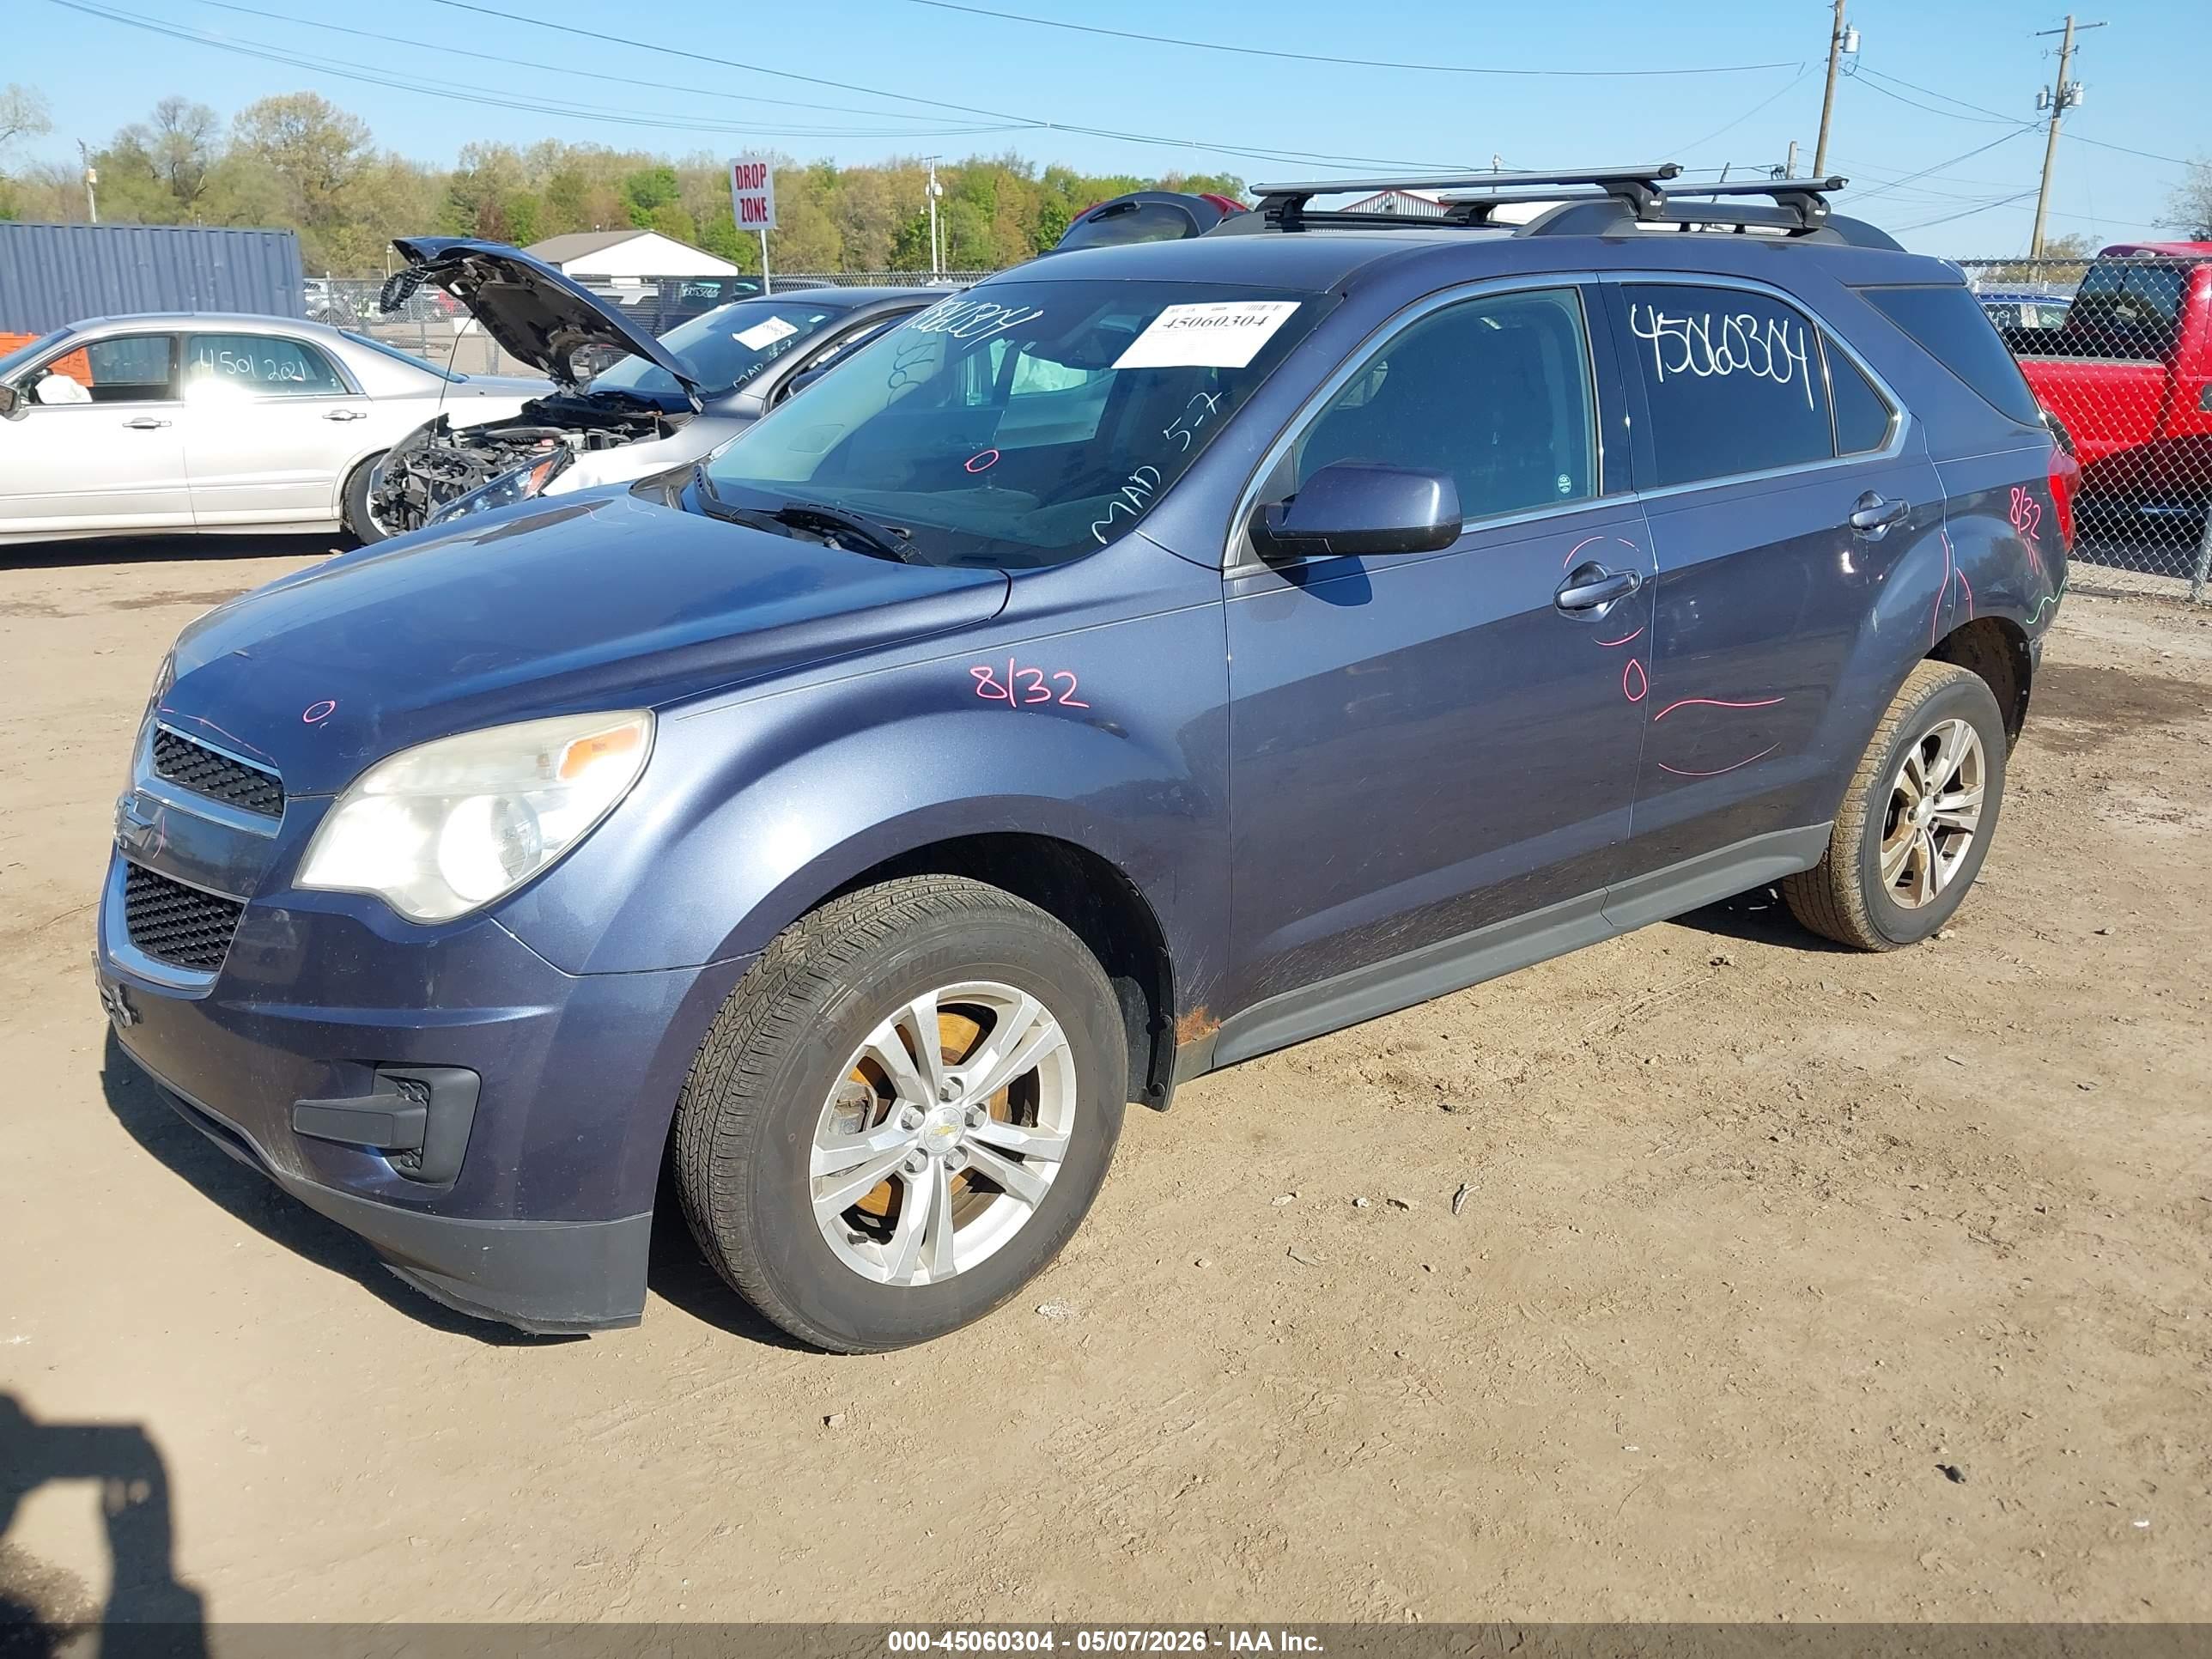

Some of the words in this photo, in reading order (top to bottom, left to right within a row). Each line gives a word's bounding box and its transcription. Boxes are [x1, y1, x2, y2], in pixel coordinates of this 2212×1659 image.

[735, 163, 767, 190] DROP
[740, 197, 769, 222] ZONE
[1163, 315, 1270, 329] 45060304
[732, 362, 763, 388] MAD
[1631, 303, 1814, 411] 45060304
[1091, 465, 1161, 544] MAD
[1163, 392, 1223, 453] 5-7
[2010, 485, 2041, 540] 8/32
[969, 657, 1090, 708] 8/32
